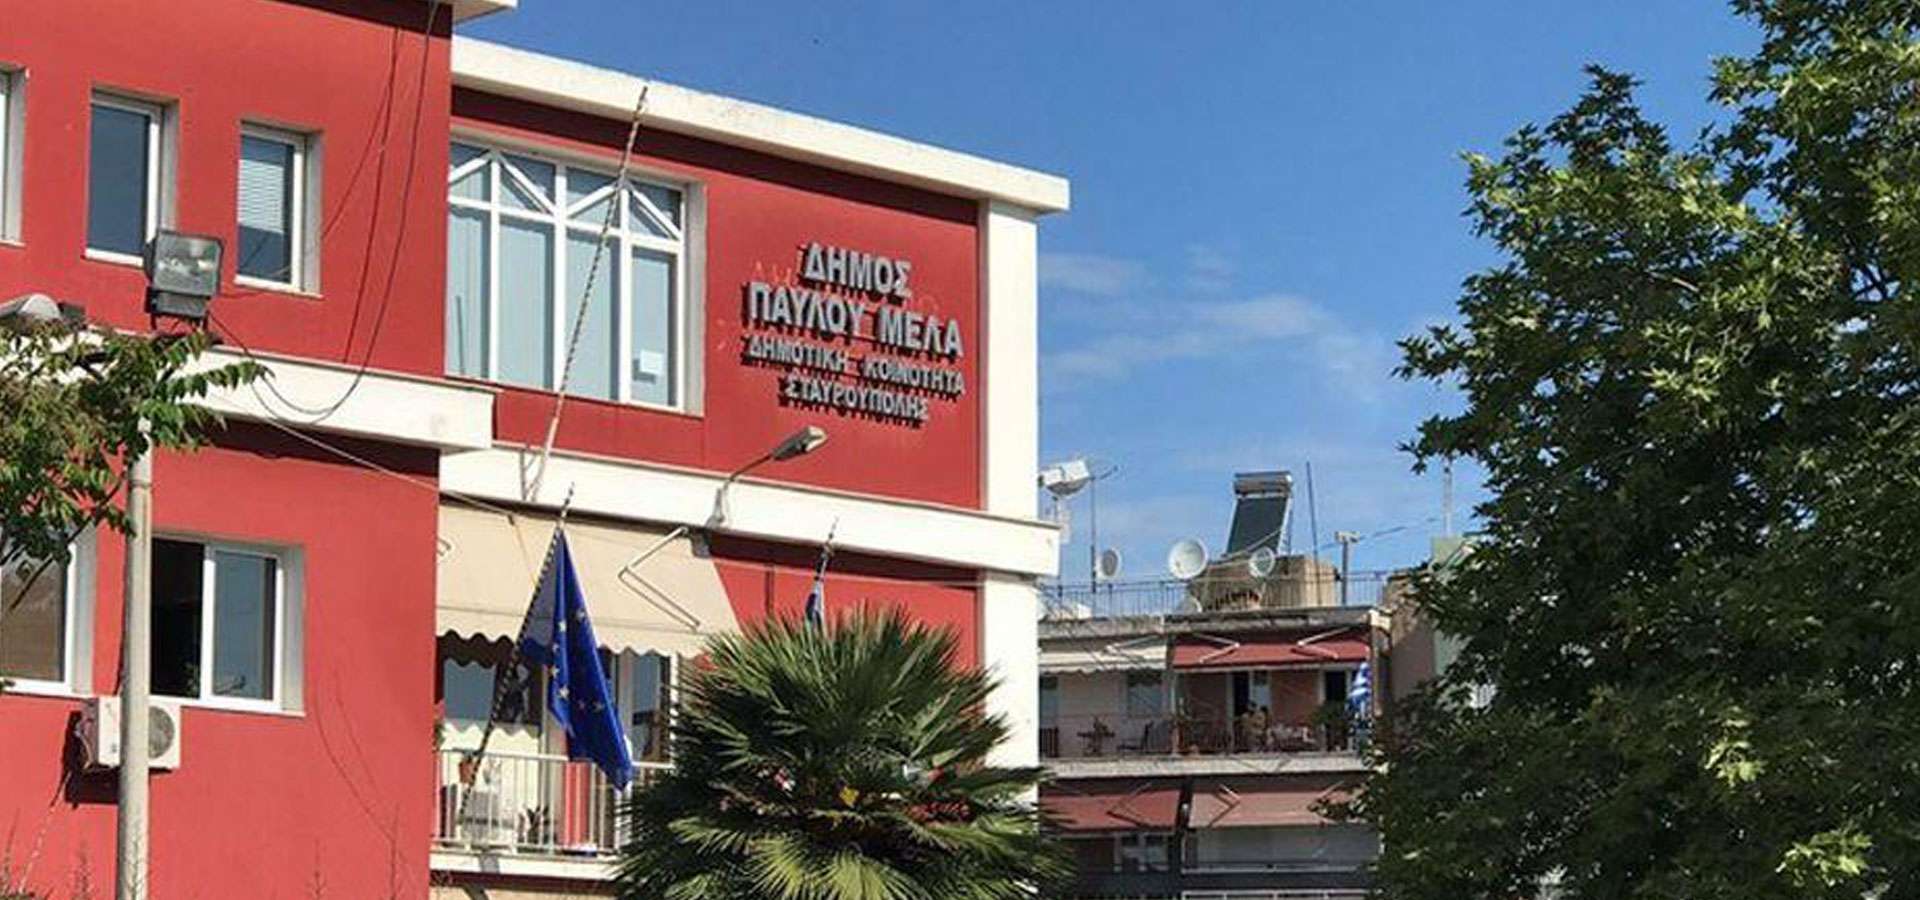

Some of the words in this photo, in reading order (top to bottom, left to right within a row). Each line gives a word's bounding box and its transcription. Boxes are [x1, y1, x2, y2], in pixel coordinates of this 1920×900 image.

[803, 243, 912, 299] ΔΗΜΟΣ
[749, 281, 866, 336] ΠΑΥΛΟΥ
[879, 307, 964, 358] ΜΕΛΑ
[749, 335, 848, 372] ΔΗΜΟΤΙΚΗ
[863, 355, 966, 395] ΚΟΙΝΟΤΗΤΑ
[785, 374, 929, 421] ΣΤΑΥΡΟΥΠΟΛΗΣ
